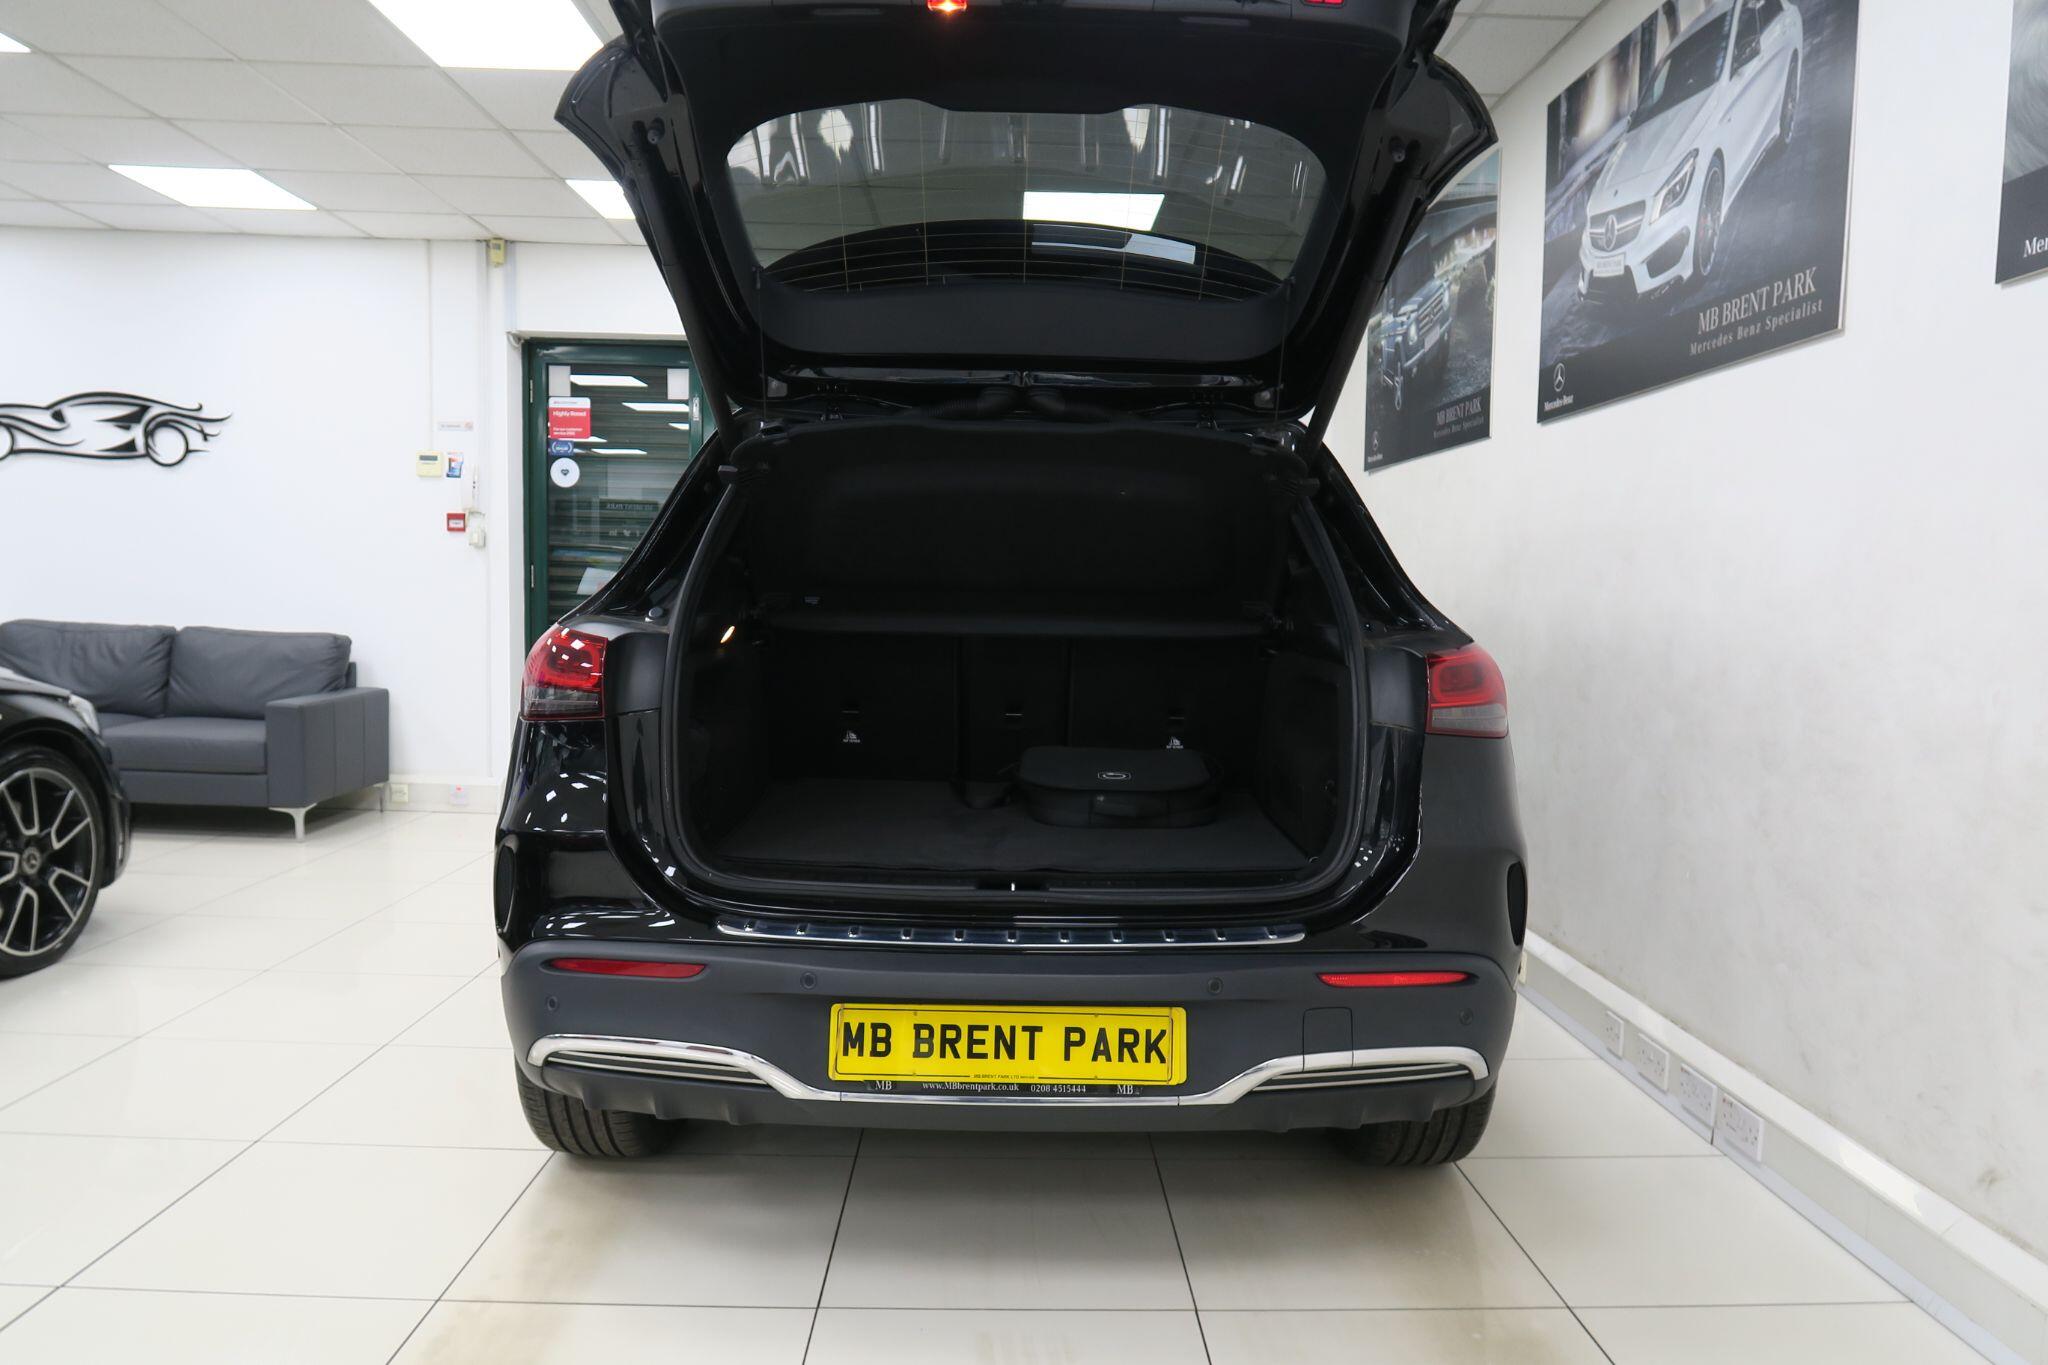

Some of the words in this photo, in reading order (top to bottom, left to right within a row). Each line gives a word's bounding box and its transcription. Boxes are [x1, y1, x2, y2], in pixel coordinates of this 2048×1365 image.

[1697, 305, 1719, 335] MB
[1722, 286, 1770, 326] BRENT
[1772, 266, 1818, 308] PARK
[1689, 331, 1734, 356] Mercedes
[1737, 321, 1761, 340] Benz
[1765, 299, 1823, 332] Specialist
[1465, 396, 1482, 417] PARK
[842, 1022, 892, 1058] MB
[912, 1023, 1043, 1061] BRENT
[1064, 1026, 1168, 1064] PARK
[875, 1080, 892, 1091] MB
[922, 1082, 1020, 1092] www.MBbrentpark.co.uk
[1030, 1084, 1050, 1093] 0208
[1052, 1084, 1087, 1093] 4515444
[1117, 1085, 1134, 1095] MB
